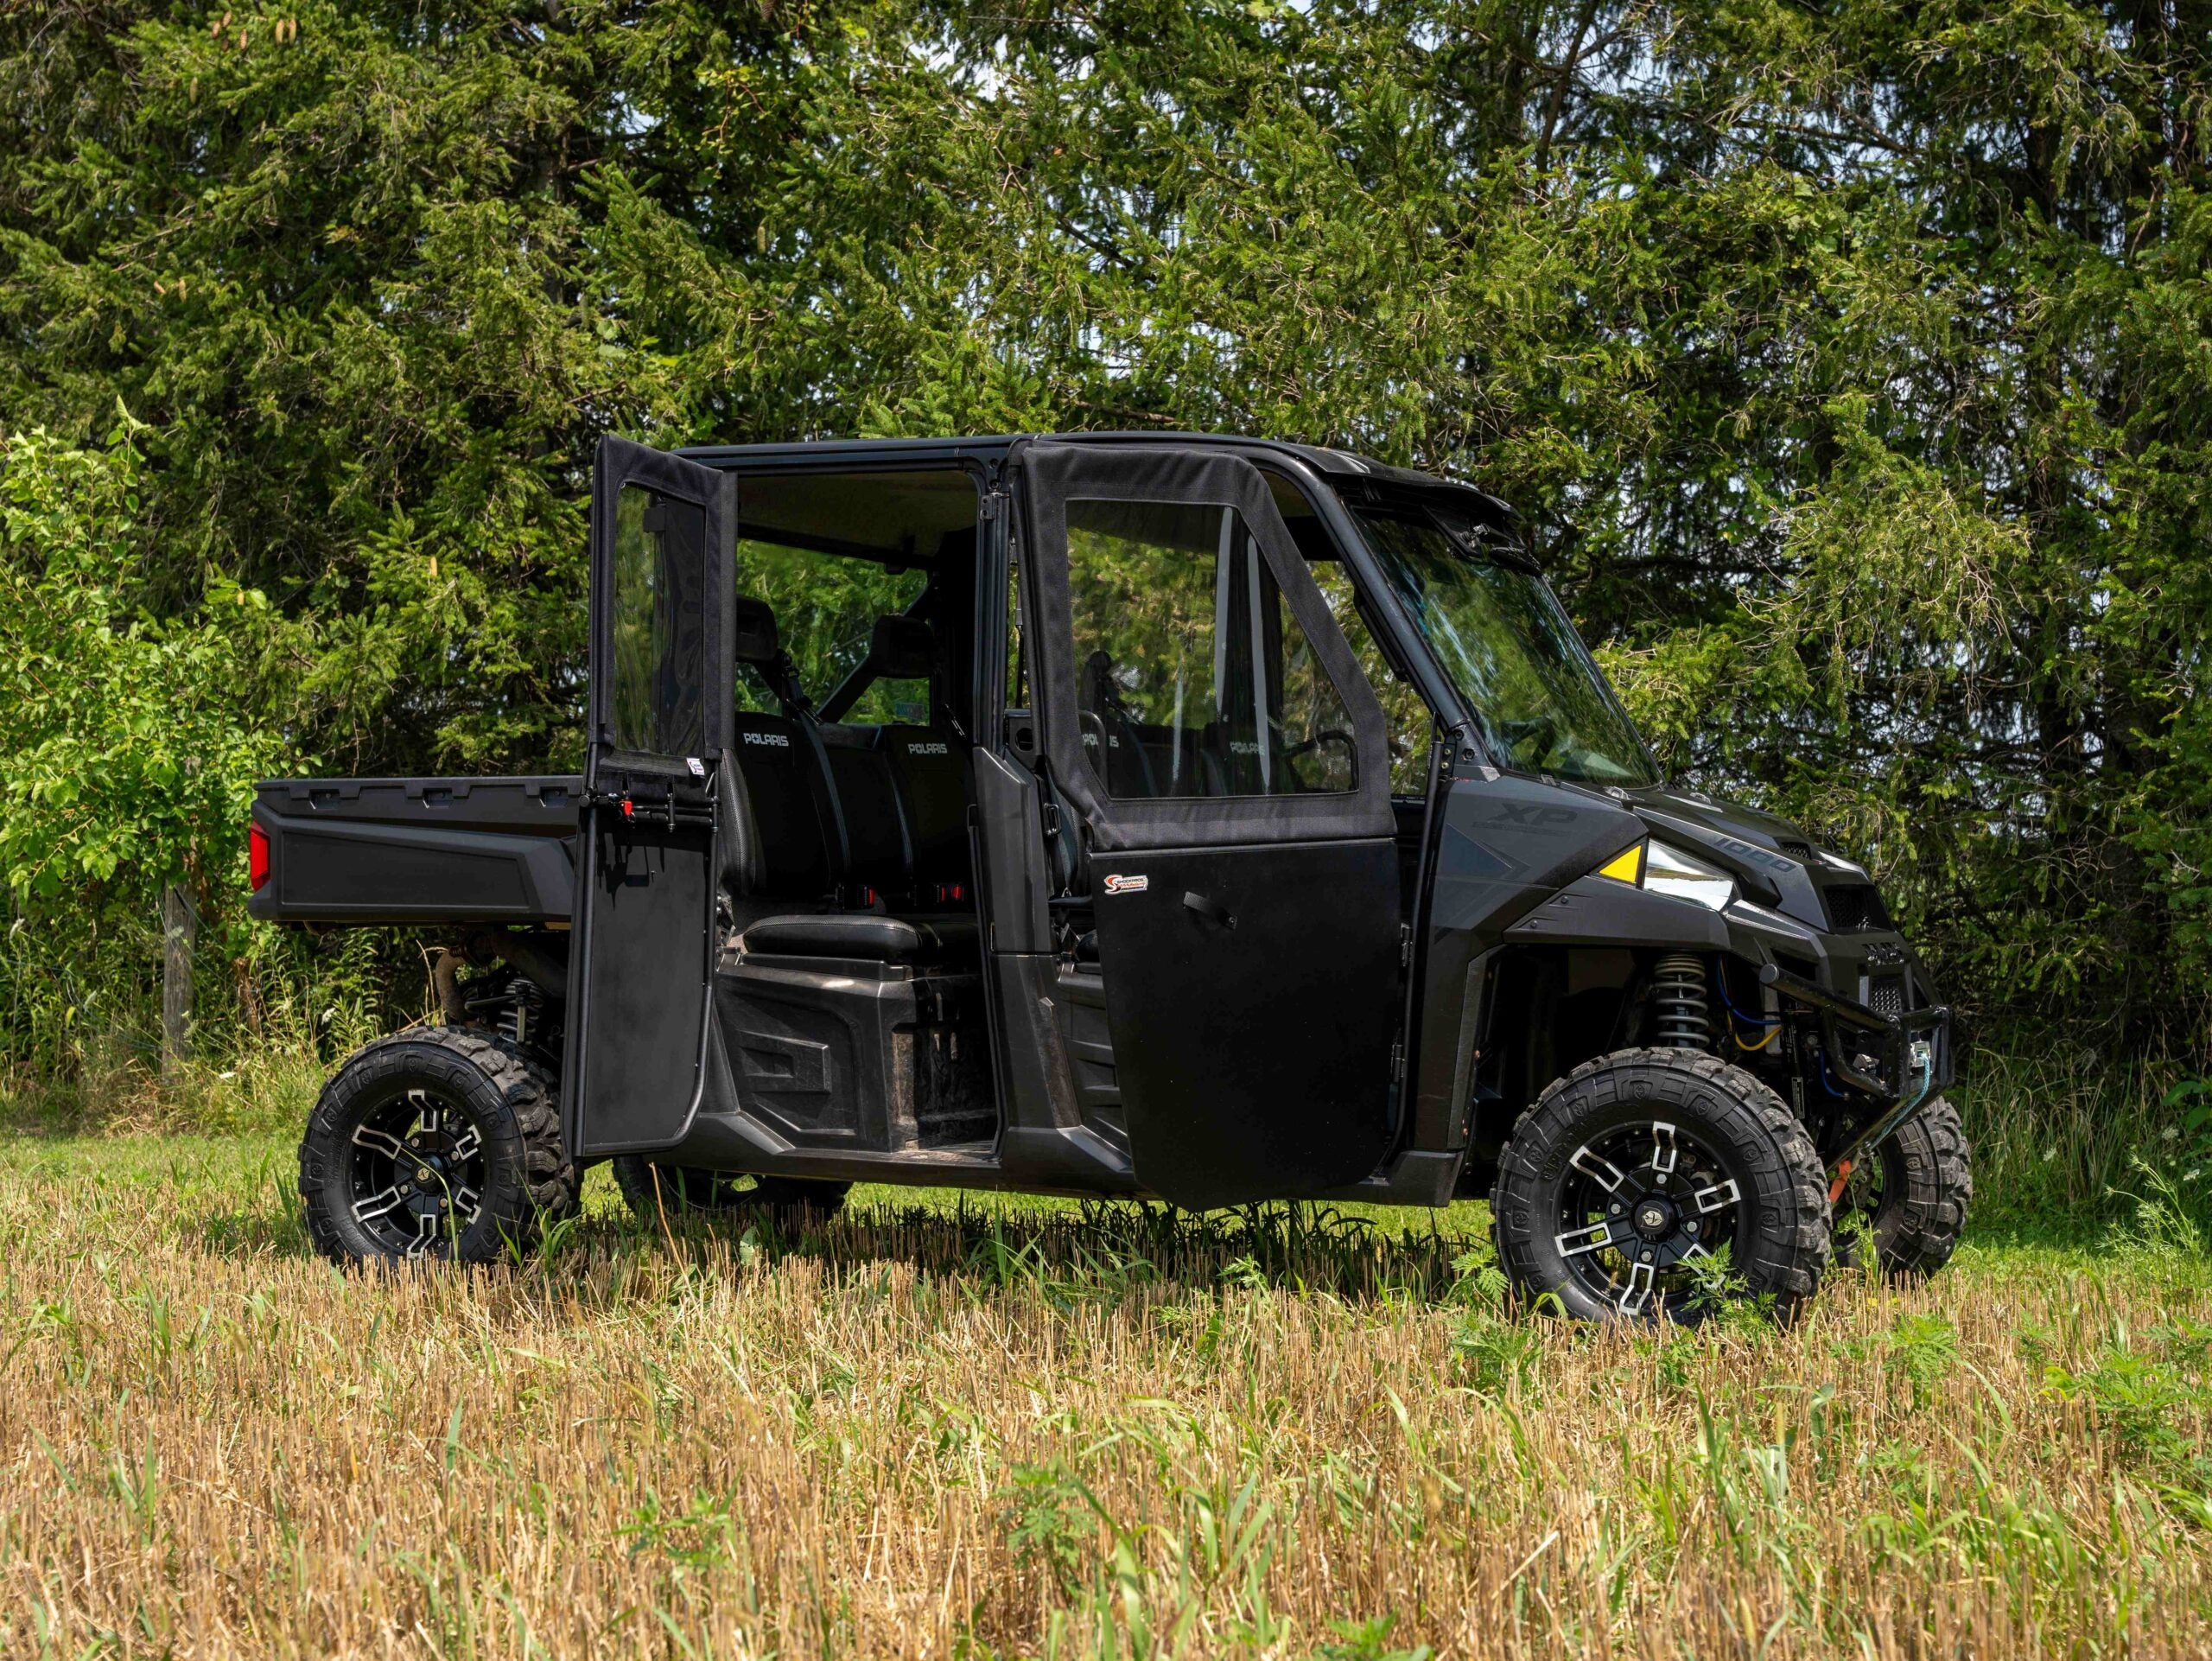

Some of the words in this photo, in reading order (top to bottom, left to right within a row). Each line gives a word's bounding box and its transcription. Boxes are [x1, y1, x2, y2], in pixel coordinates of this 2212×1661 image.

[743, 733, 789, 747] POLARIS
[1082, 733, 1119, 748] POLIS
[908, 743, 948, 754] POLARIS
[1486, 802, 1579, 824] XP
[1713, 837, 1797, 873] 1000
